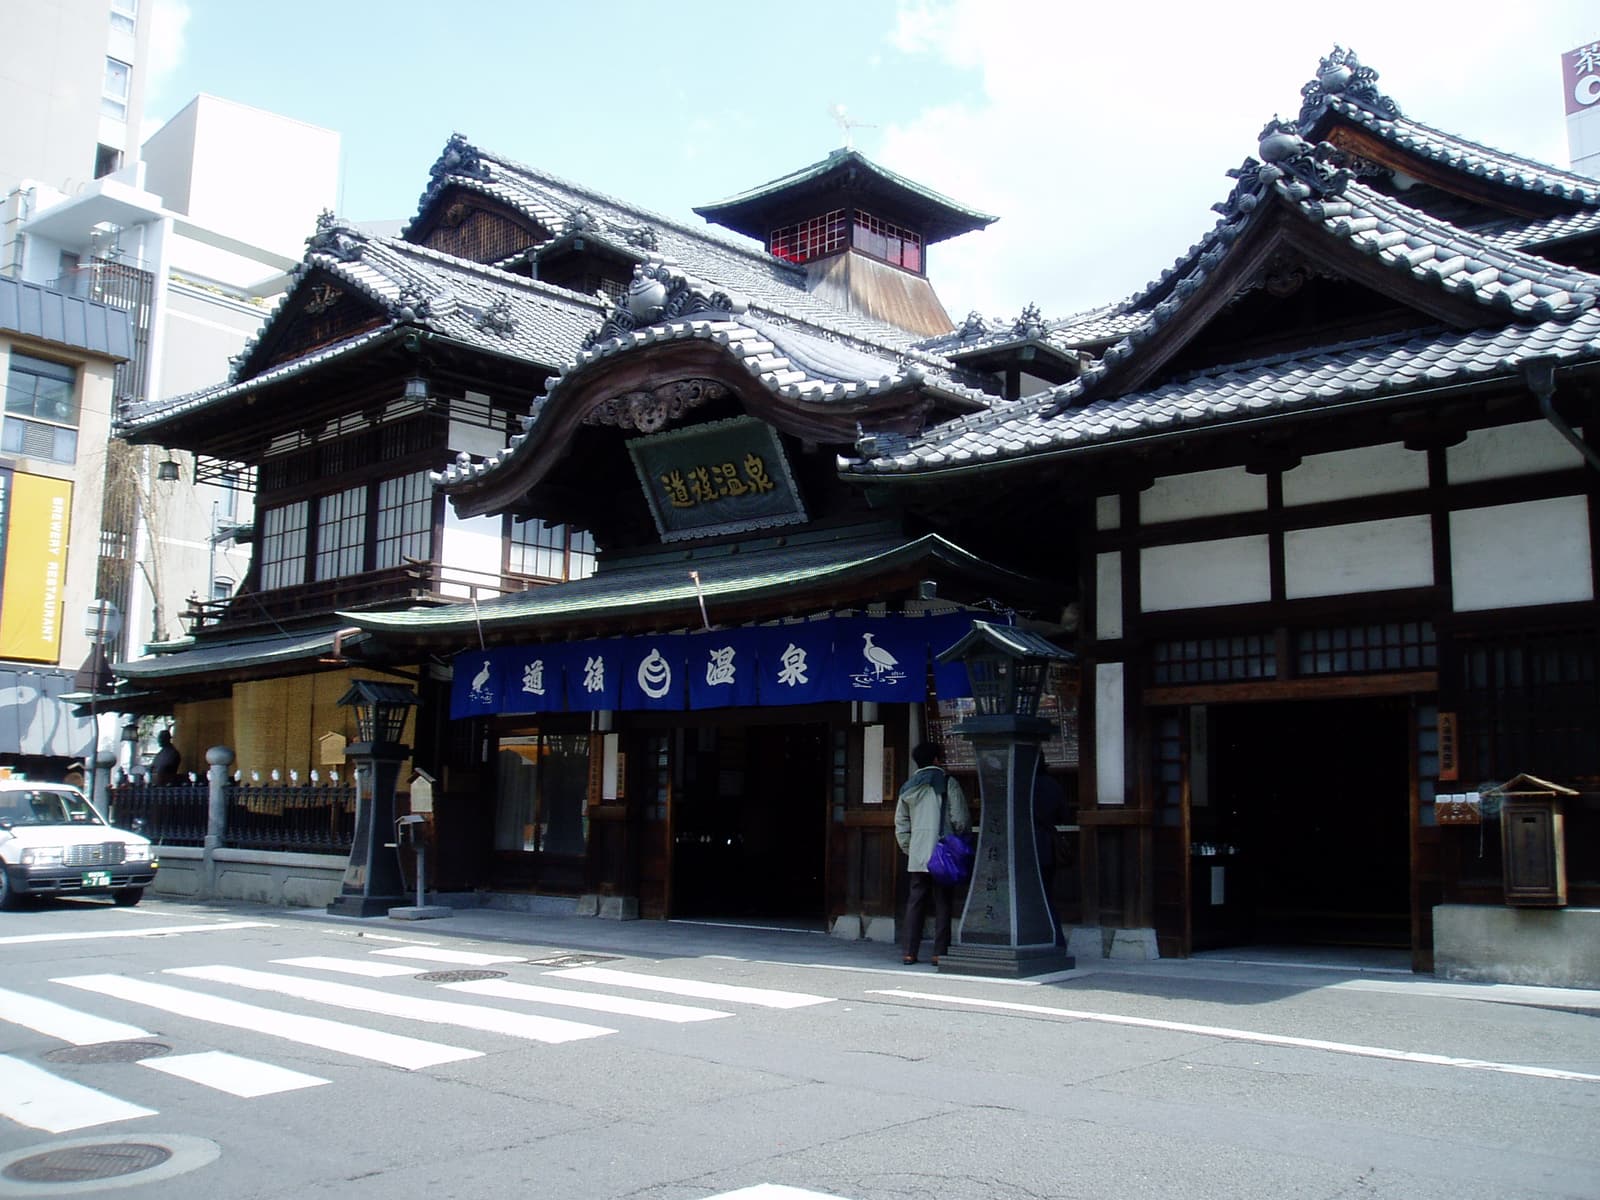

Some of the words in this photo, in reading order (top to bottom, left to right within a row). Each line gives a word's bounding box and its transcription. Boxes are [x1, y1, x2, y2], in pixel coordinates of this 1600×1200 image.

[661, 453, 774, 508] 道後温泉
[48, 497, 64, 555] BREWERY
[41, 562, 59, 642] RESTAURANT
